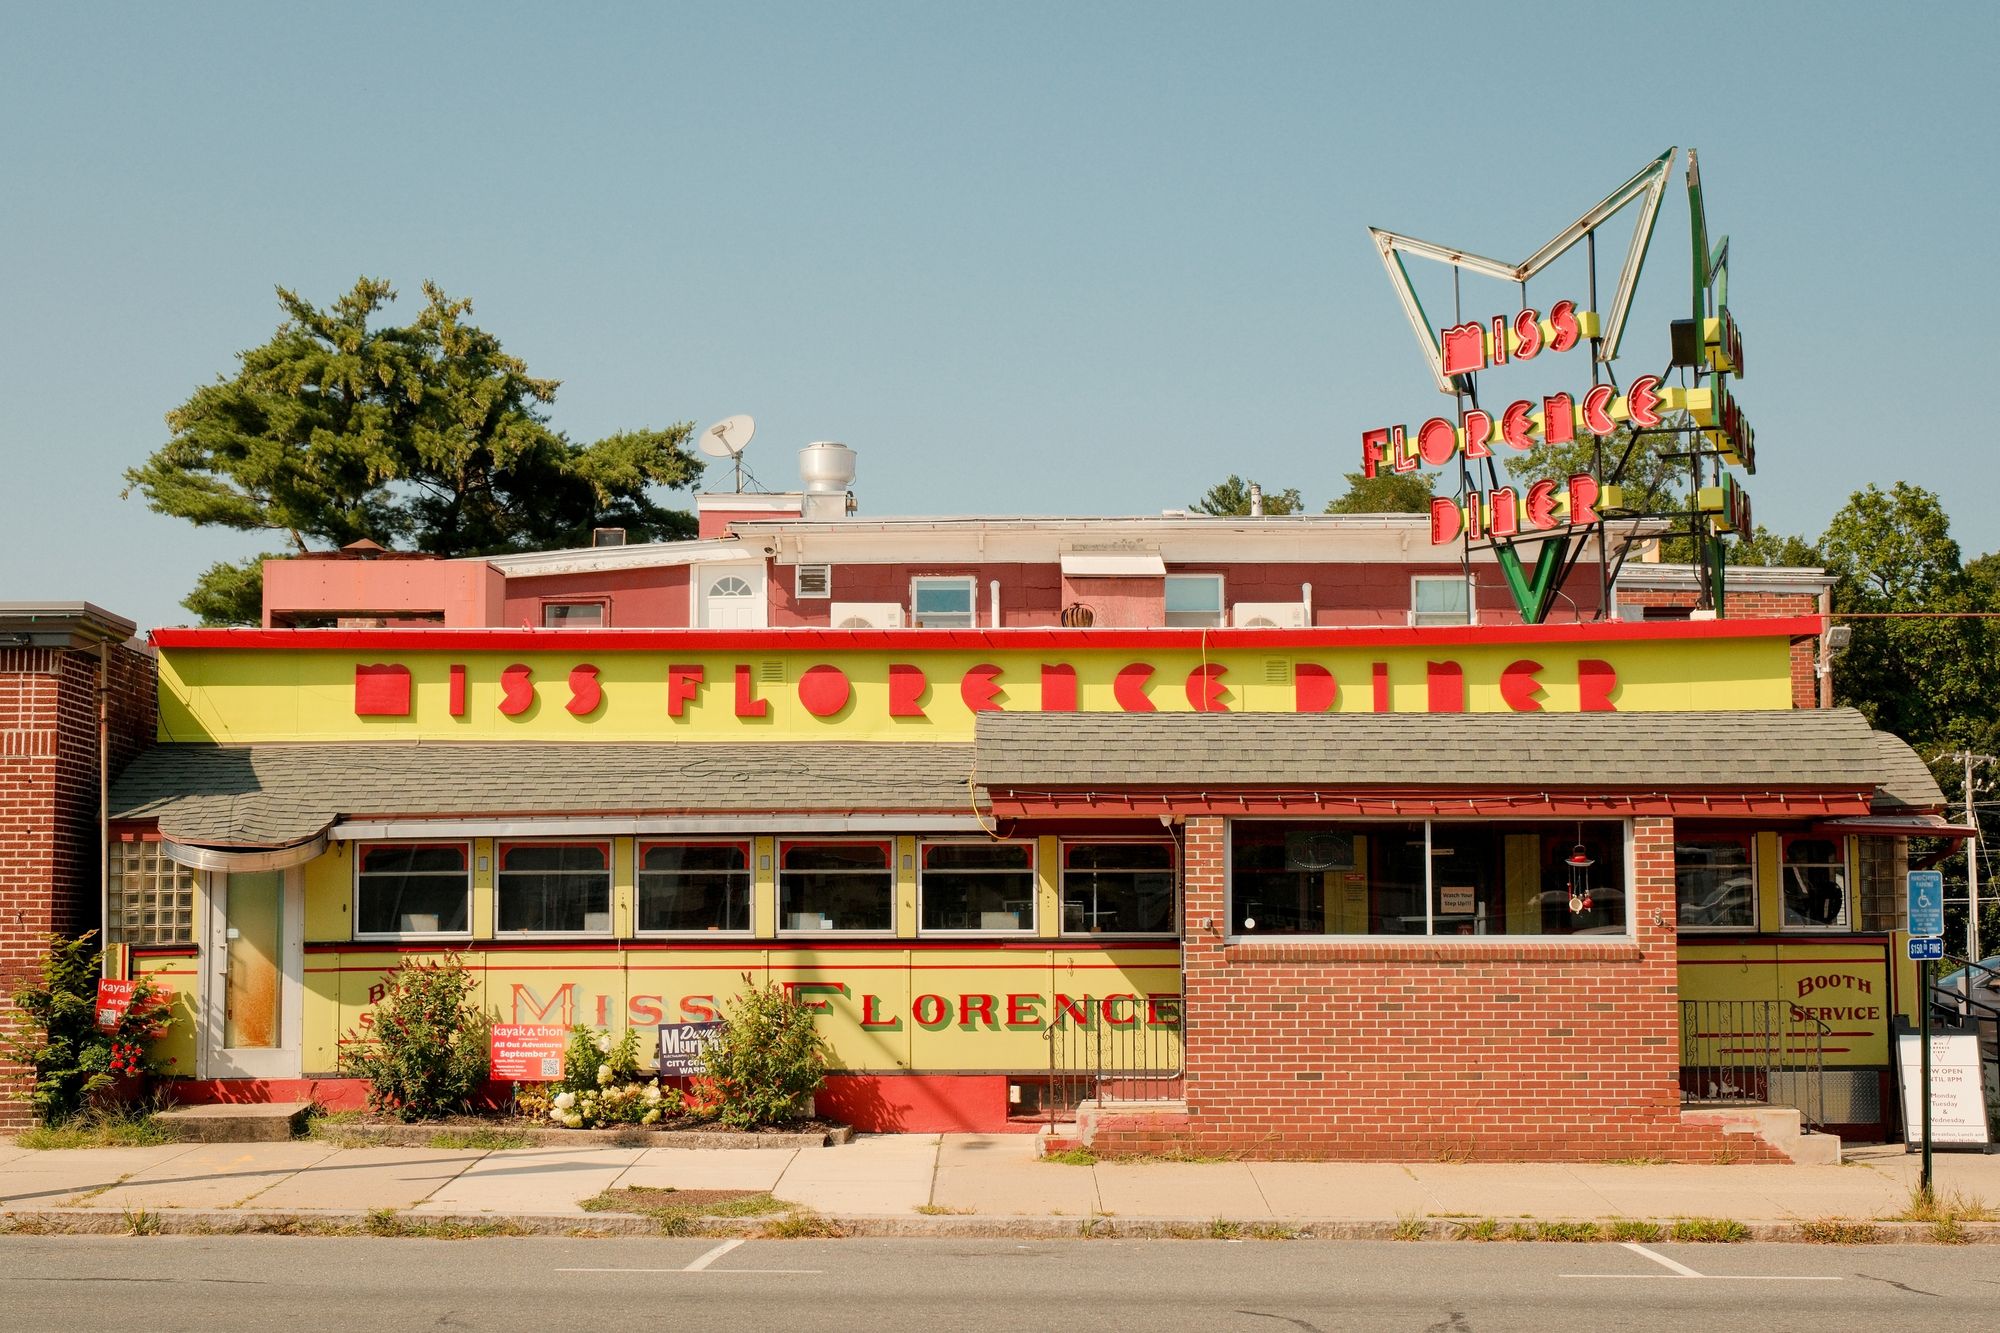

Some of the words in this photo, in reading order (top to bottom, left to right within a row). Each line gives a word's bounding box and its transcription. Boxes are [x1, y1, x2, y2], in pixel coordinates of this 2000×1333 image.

[1440, 299, 1582, 377] MISS
[1362, 374, 1665, 479] FLORENCE
[1430, 472, 1604, 546] DINER
[354, 663, 602, 716] MISS
[667, 662, 1230, 717] FLORENCE
[1295, 660, 1618, 712] DINER
[1929, 943, 1941, 954] FINE
[101, 981, 133, 994] kayak
[1797, 974, 1873, 998] BOOTH
[511, 983, 718, 1031] MISS
[1789, 1006, 1880, 1023] SERVICE
[494, 1025, 525, 1038] kayak
[527, 1028, 535, 1036] A
[537, 1026, 563, 1036] thon
